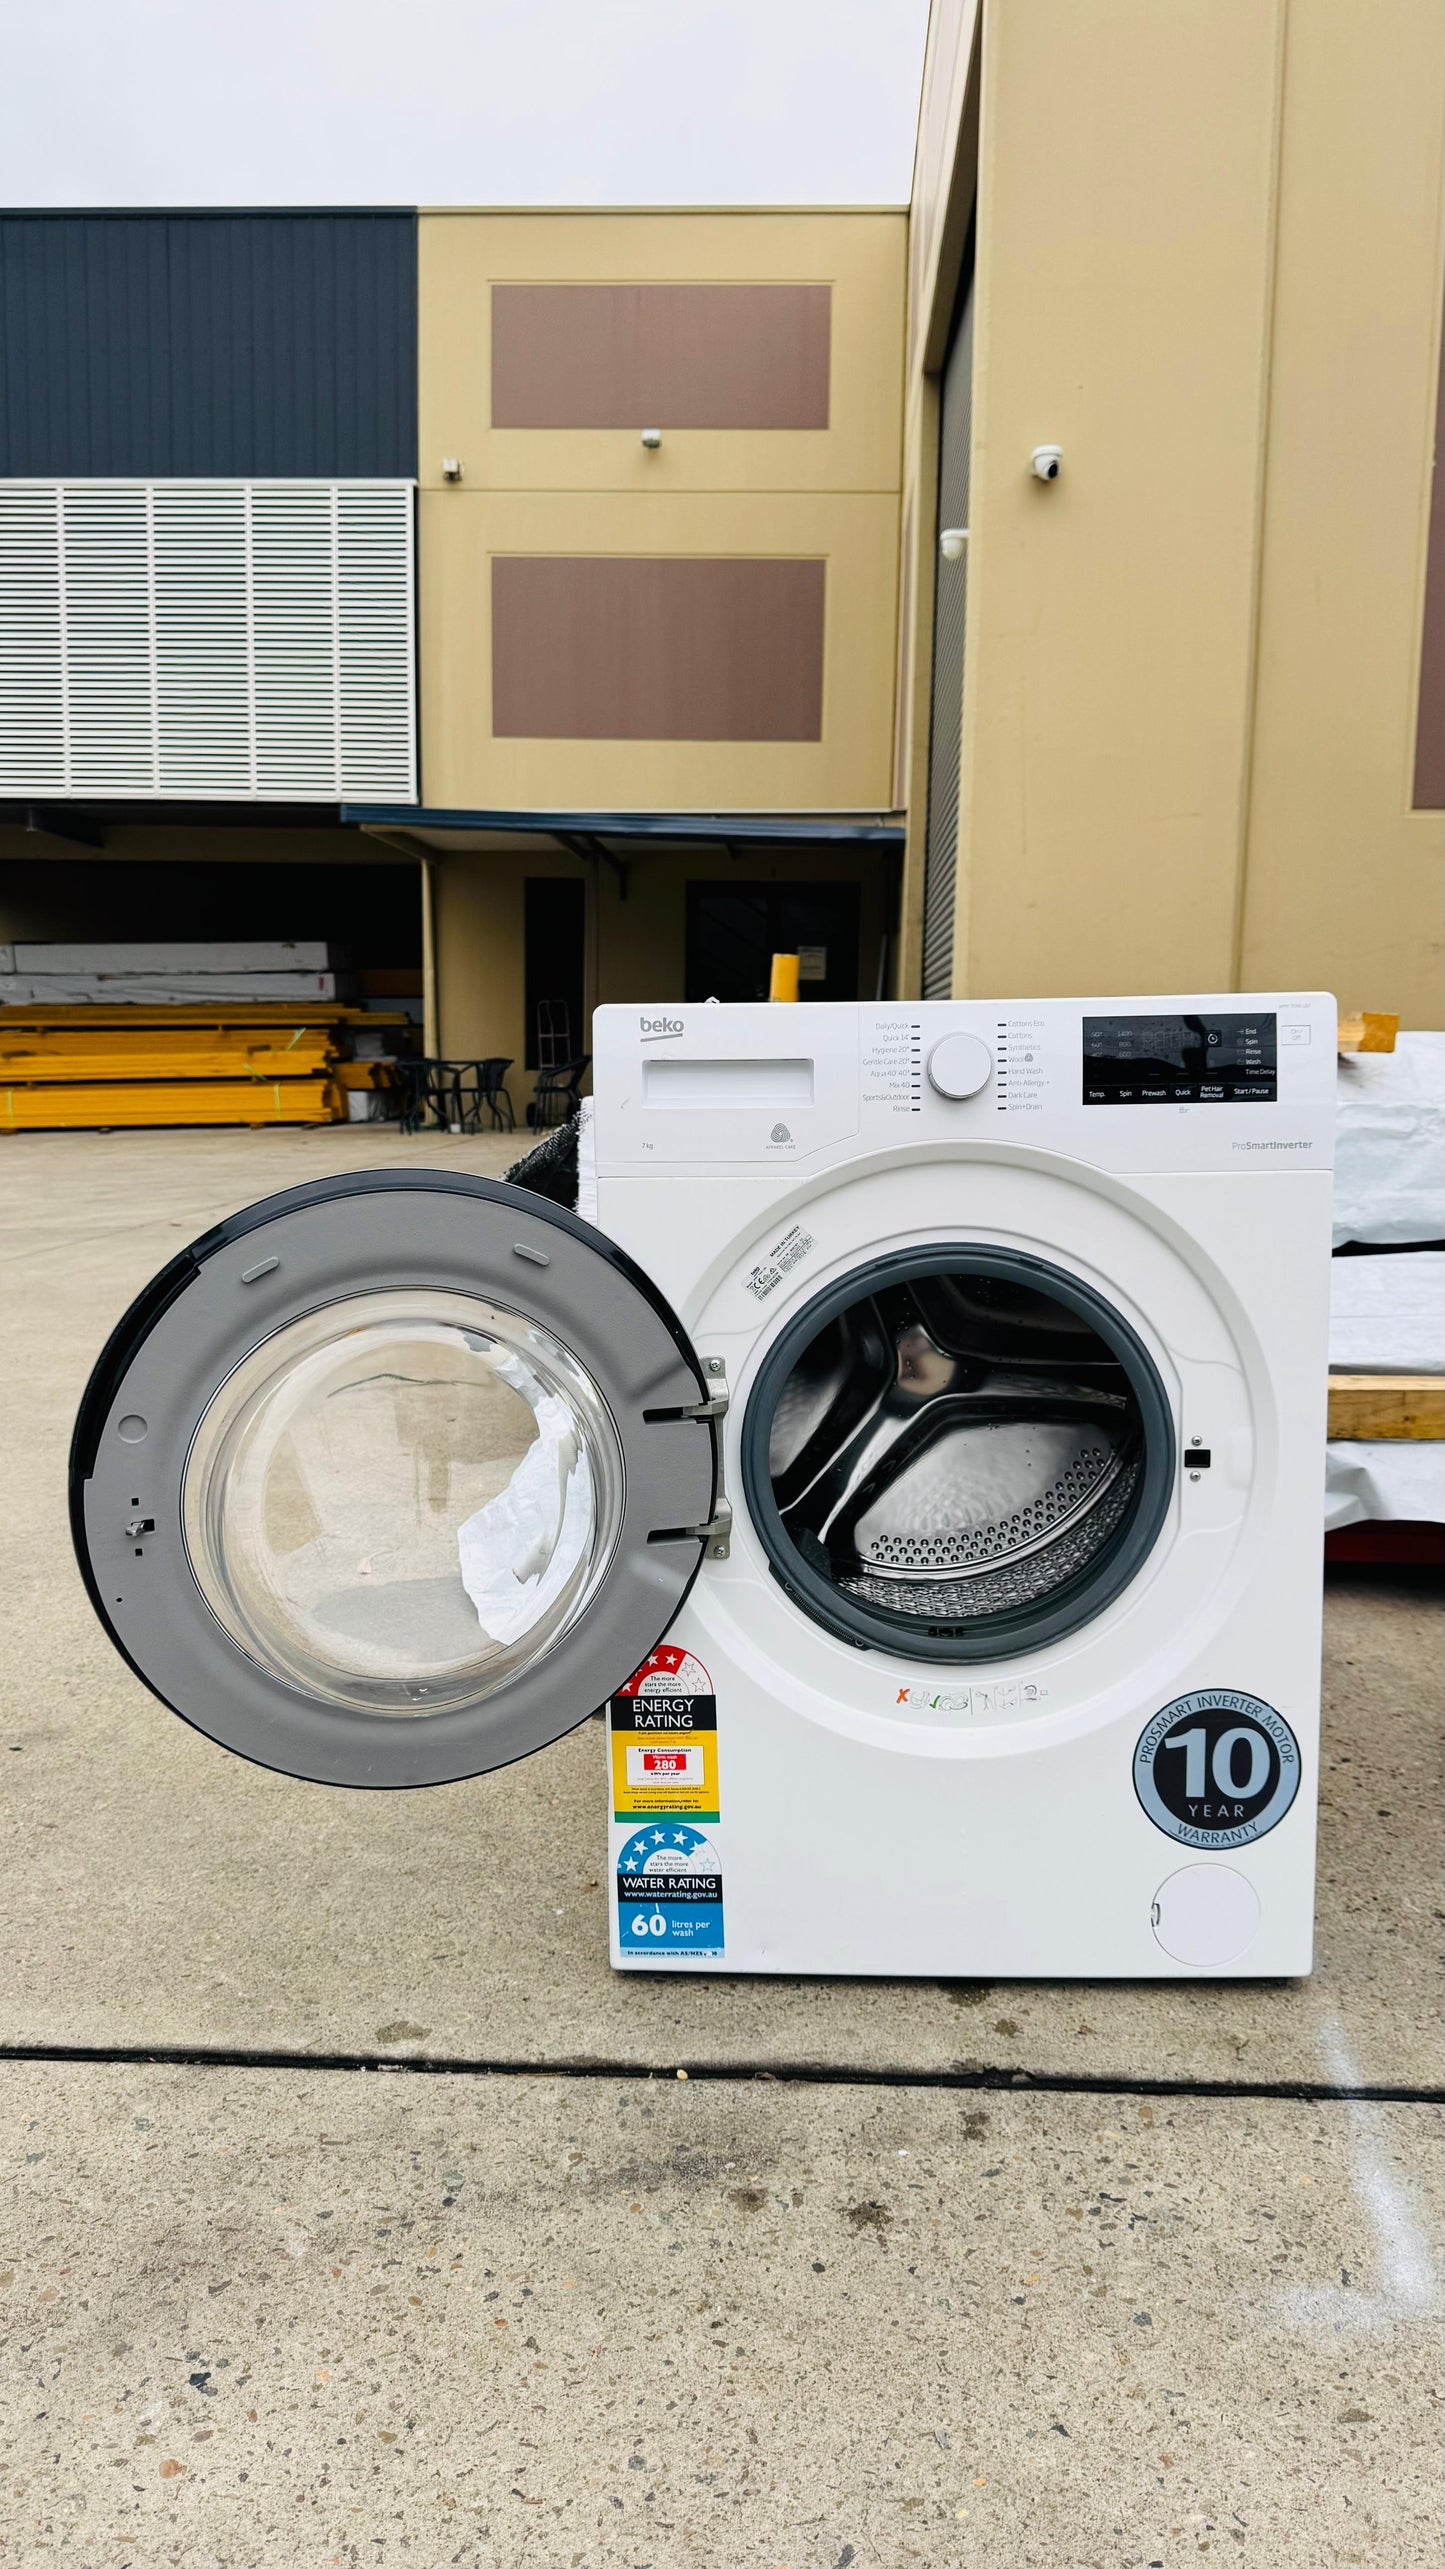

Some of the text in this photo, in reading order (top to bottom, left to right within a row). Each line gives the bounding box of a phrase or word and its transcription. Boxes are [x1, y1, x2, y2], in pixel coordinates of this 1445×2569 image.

[640, 1017, 684, 1033] beko
[1008, 1044, 1041, 1052] Synthetics
[870, 1070, 887, 1078] Aqua
[1120, 1090, 1133, 1098] Spin
[1142, 1089, 1167, 1097] Prewash
[1176, 1089, 1191, 1097] Quick
[1232, 1141, 1313, 1152] ProSmartInverter
[770, 1246, 780, 1257] MADE
[784, 1226, 800, 1241] TURKEY
[633, 1699, 694, 1712] ENERGY
[1196, 1696, 1264, 1718] INVERTER
[635, 1715, 693, 1728] RATING
[1140, 1700, 1193, 1764] PROSMART
[1262, 1715, 1295, 1764] MOTOR
[654, 1761, 676, 1770] 280
[1164, 1727, 1270, 1799] 10
[1188, 1804, 1244, 1817] YEAR
[1177, 1821, 1258, 1843] WARRANTY
[623, 1878, 716, 1889] WATER RATING
[624, 1891, 718, 1899] www.waterrating.gov.au
[632, 1914, 666, 1936] 60
[672, 1920, 710, 1930] litres per
